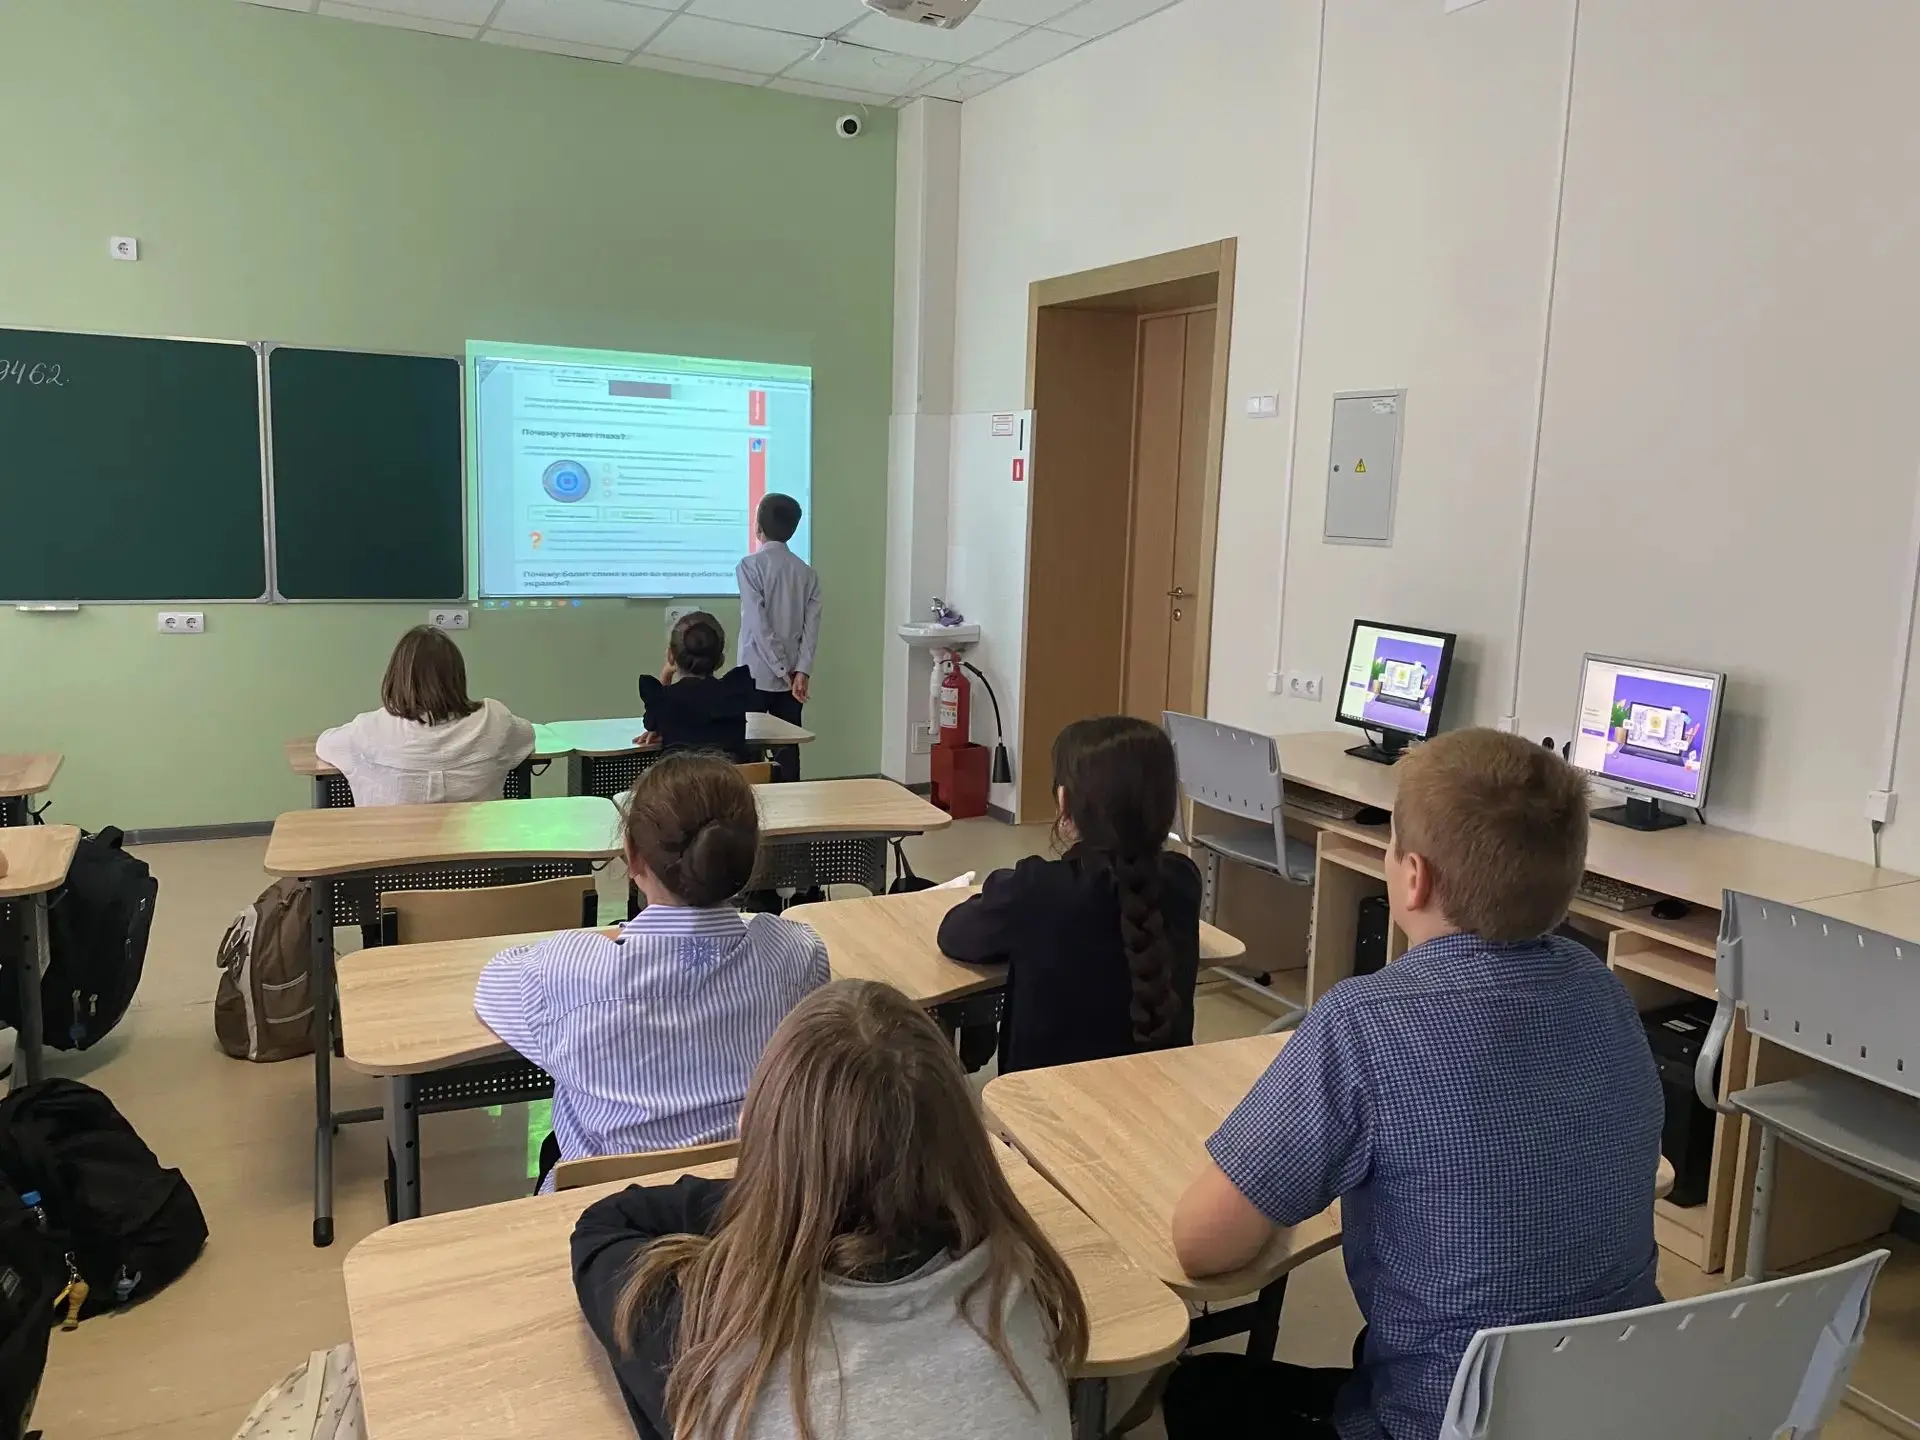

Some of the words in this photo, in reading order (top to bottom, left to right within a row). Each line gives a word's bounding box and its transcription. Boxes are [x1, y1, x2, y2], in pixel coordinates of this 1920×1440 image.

[522, 428, 559, 438] Почему
[595, 432, 626, 440] глаза?
[523, 580, 570, 588] экраном?
